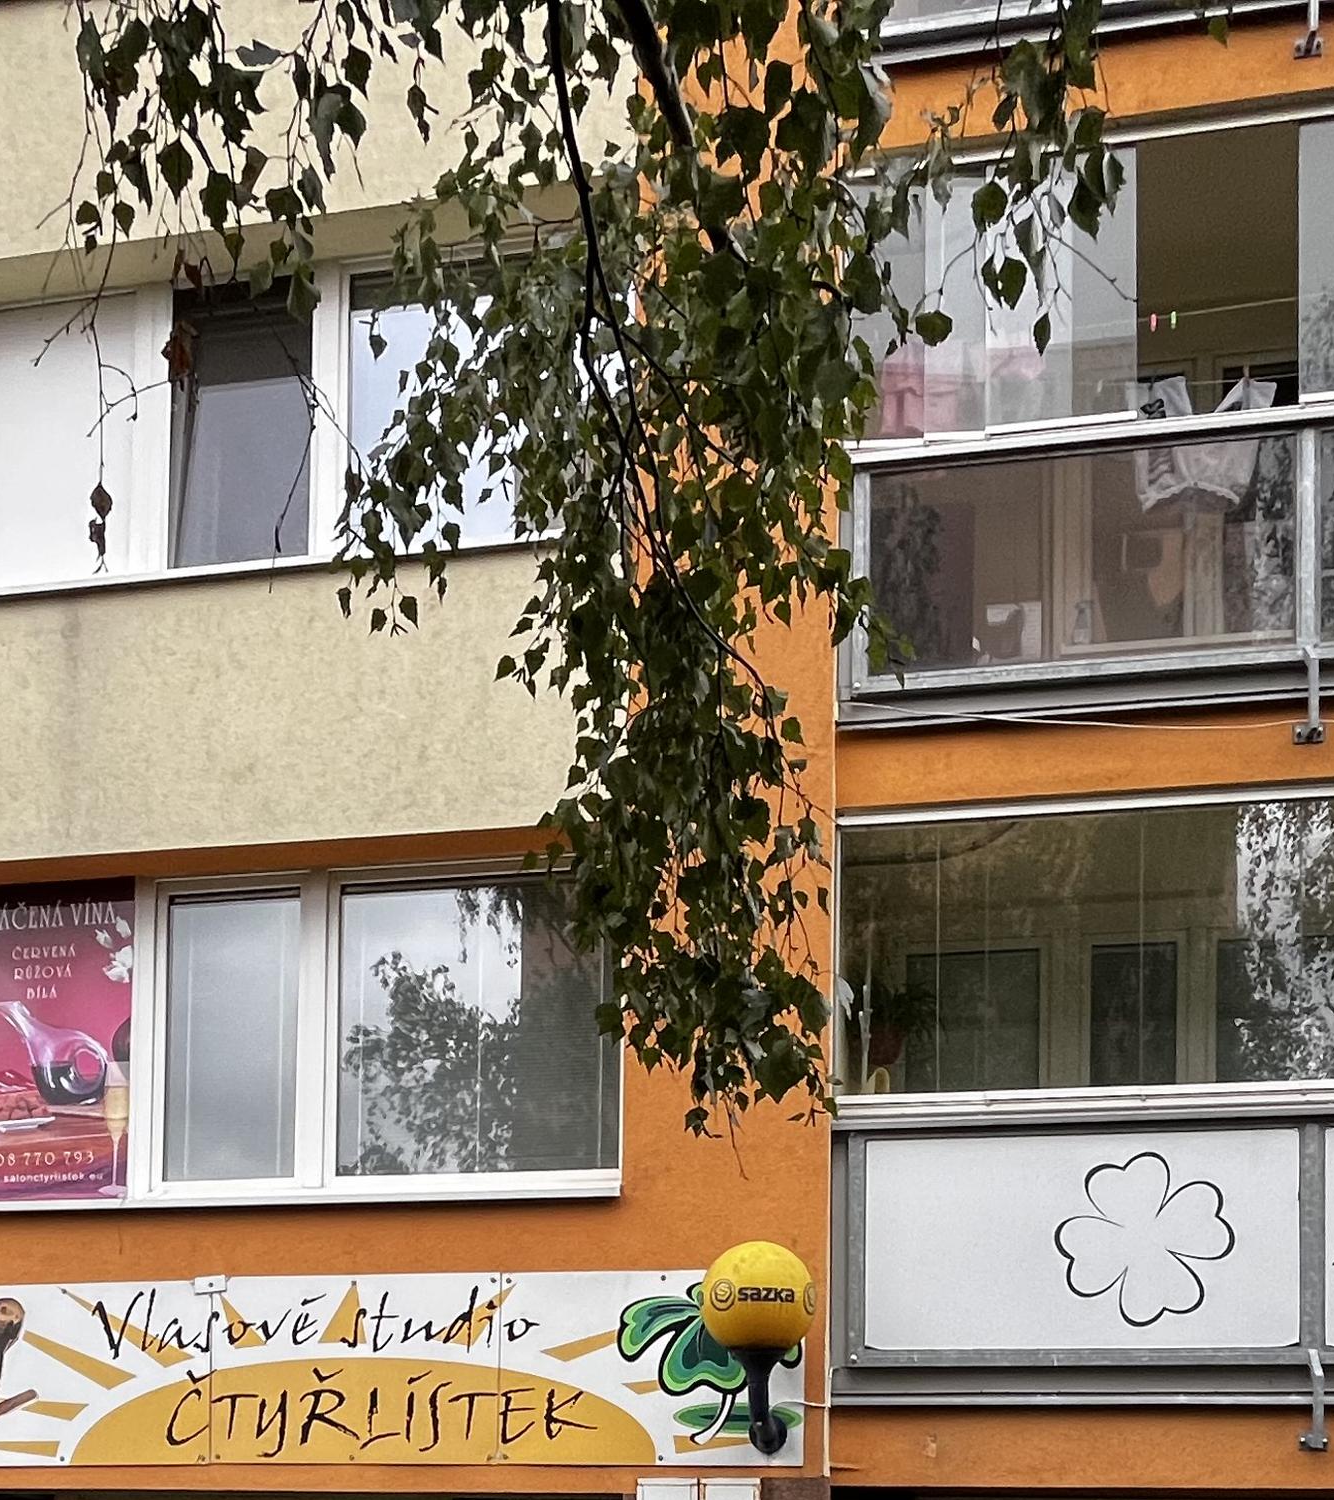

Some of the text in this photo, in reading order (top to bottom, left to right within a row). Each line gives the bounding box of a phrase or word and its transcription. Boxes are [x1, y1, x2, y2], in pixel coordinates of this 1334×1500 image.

[70, 898, 116, 926] VÍNA
[11, 943, 76, 960] ČERVENÁ
[13, 963, 72, 980] RŮŽOVÁ
[26, 984, 58, 1000] BÍLÁ
[23, 1151, 56, 1166] 770
[63, 1150, 95, 1165] 793
[91, 1285, 541, 1360] Vlasové studio
[167, 1367, 598, 1457] ČTYŘLÍSTEK
